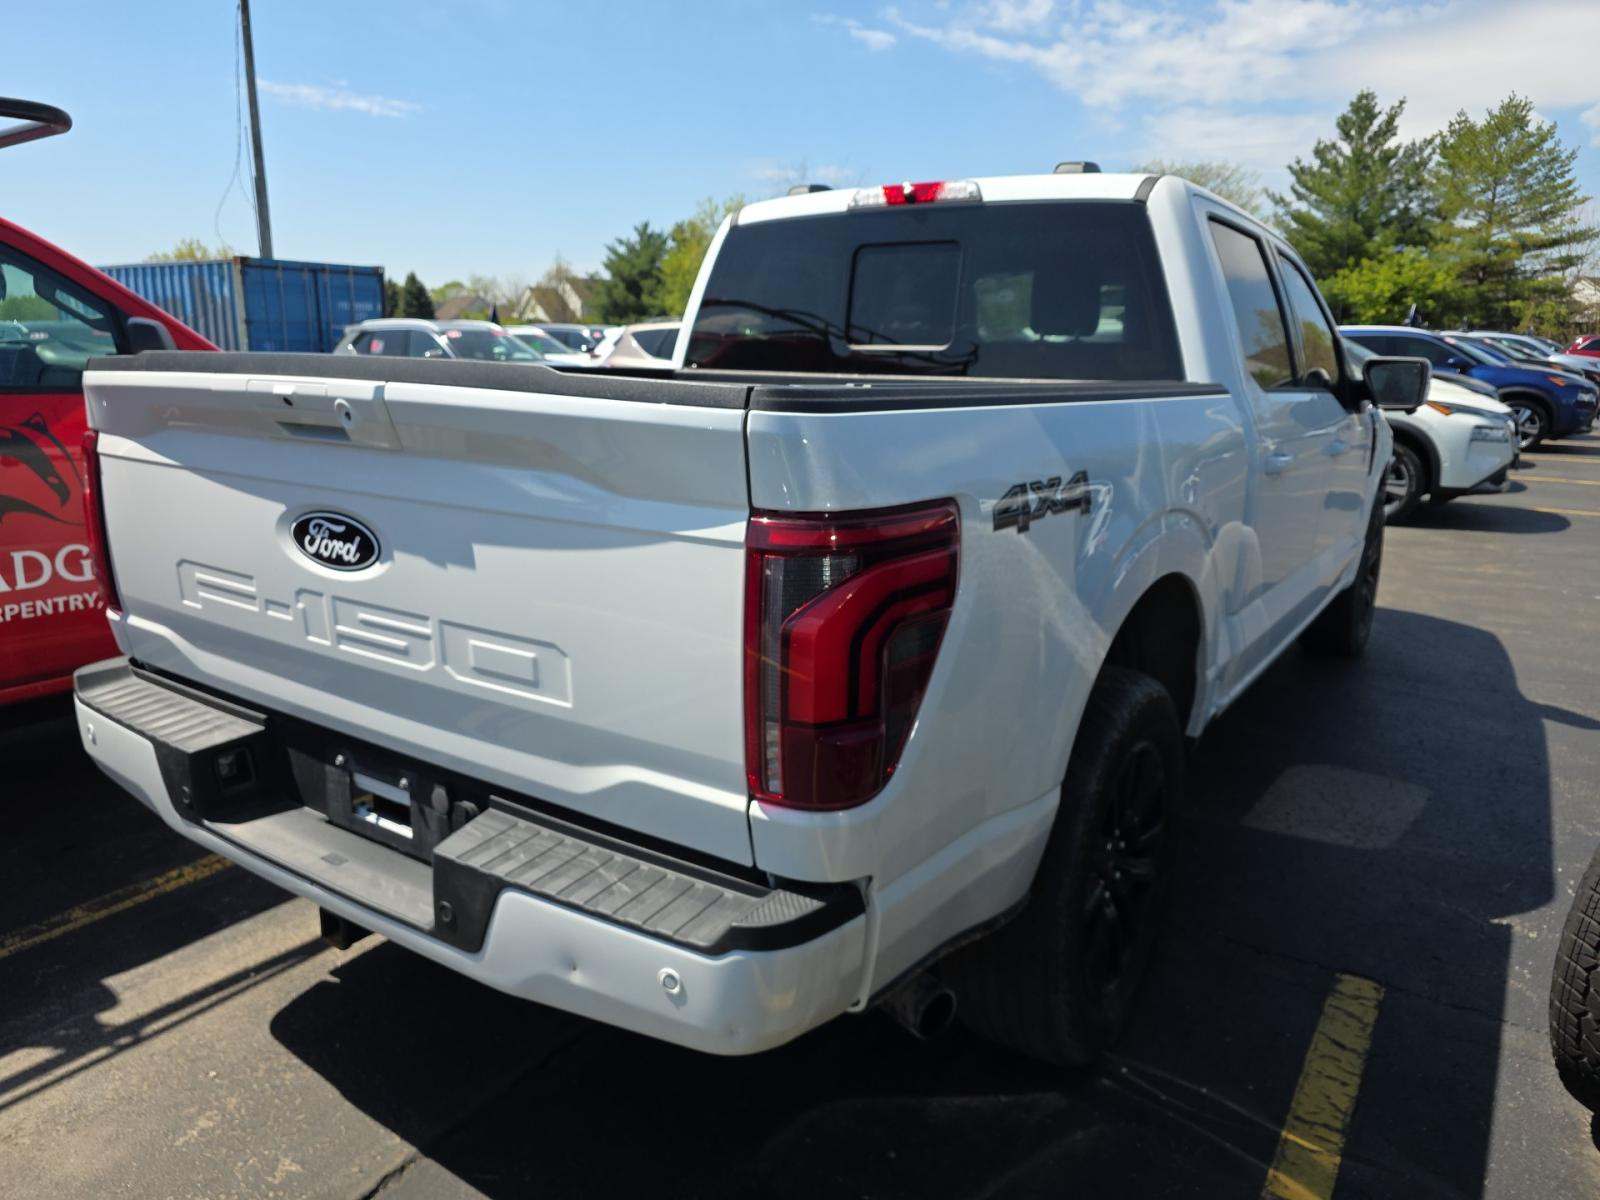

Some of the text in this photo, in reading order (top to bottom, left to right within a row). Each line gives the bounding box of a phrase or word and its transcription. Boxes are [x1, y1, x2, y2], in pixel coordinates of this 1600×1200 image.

[304, 518, 361, 563] Ford
[0, 543, 96, 593] DG
[0, 591, 104, 623] PENTRY,
[176, 558, 573, 708] F-150
